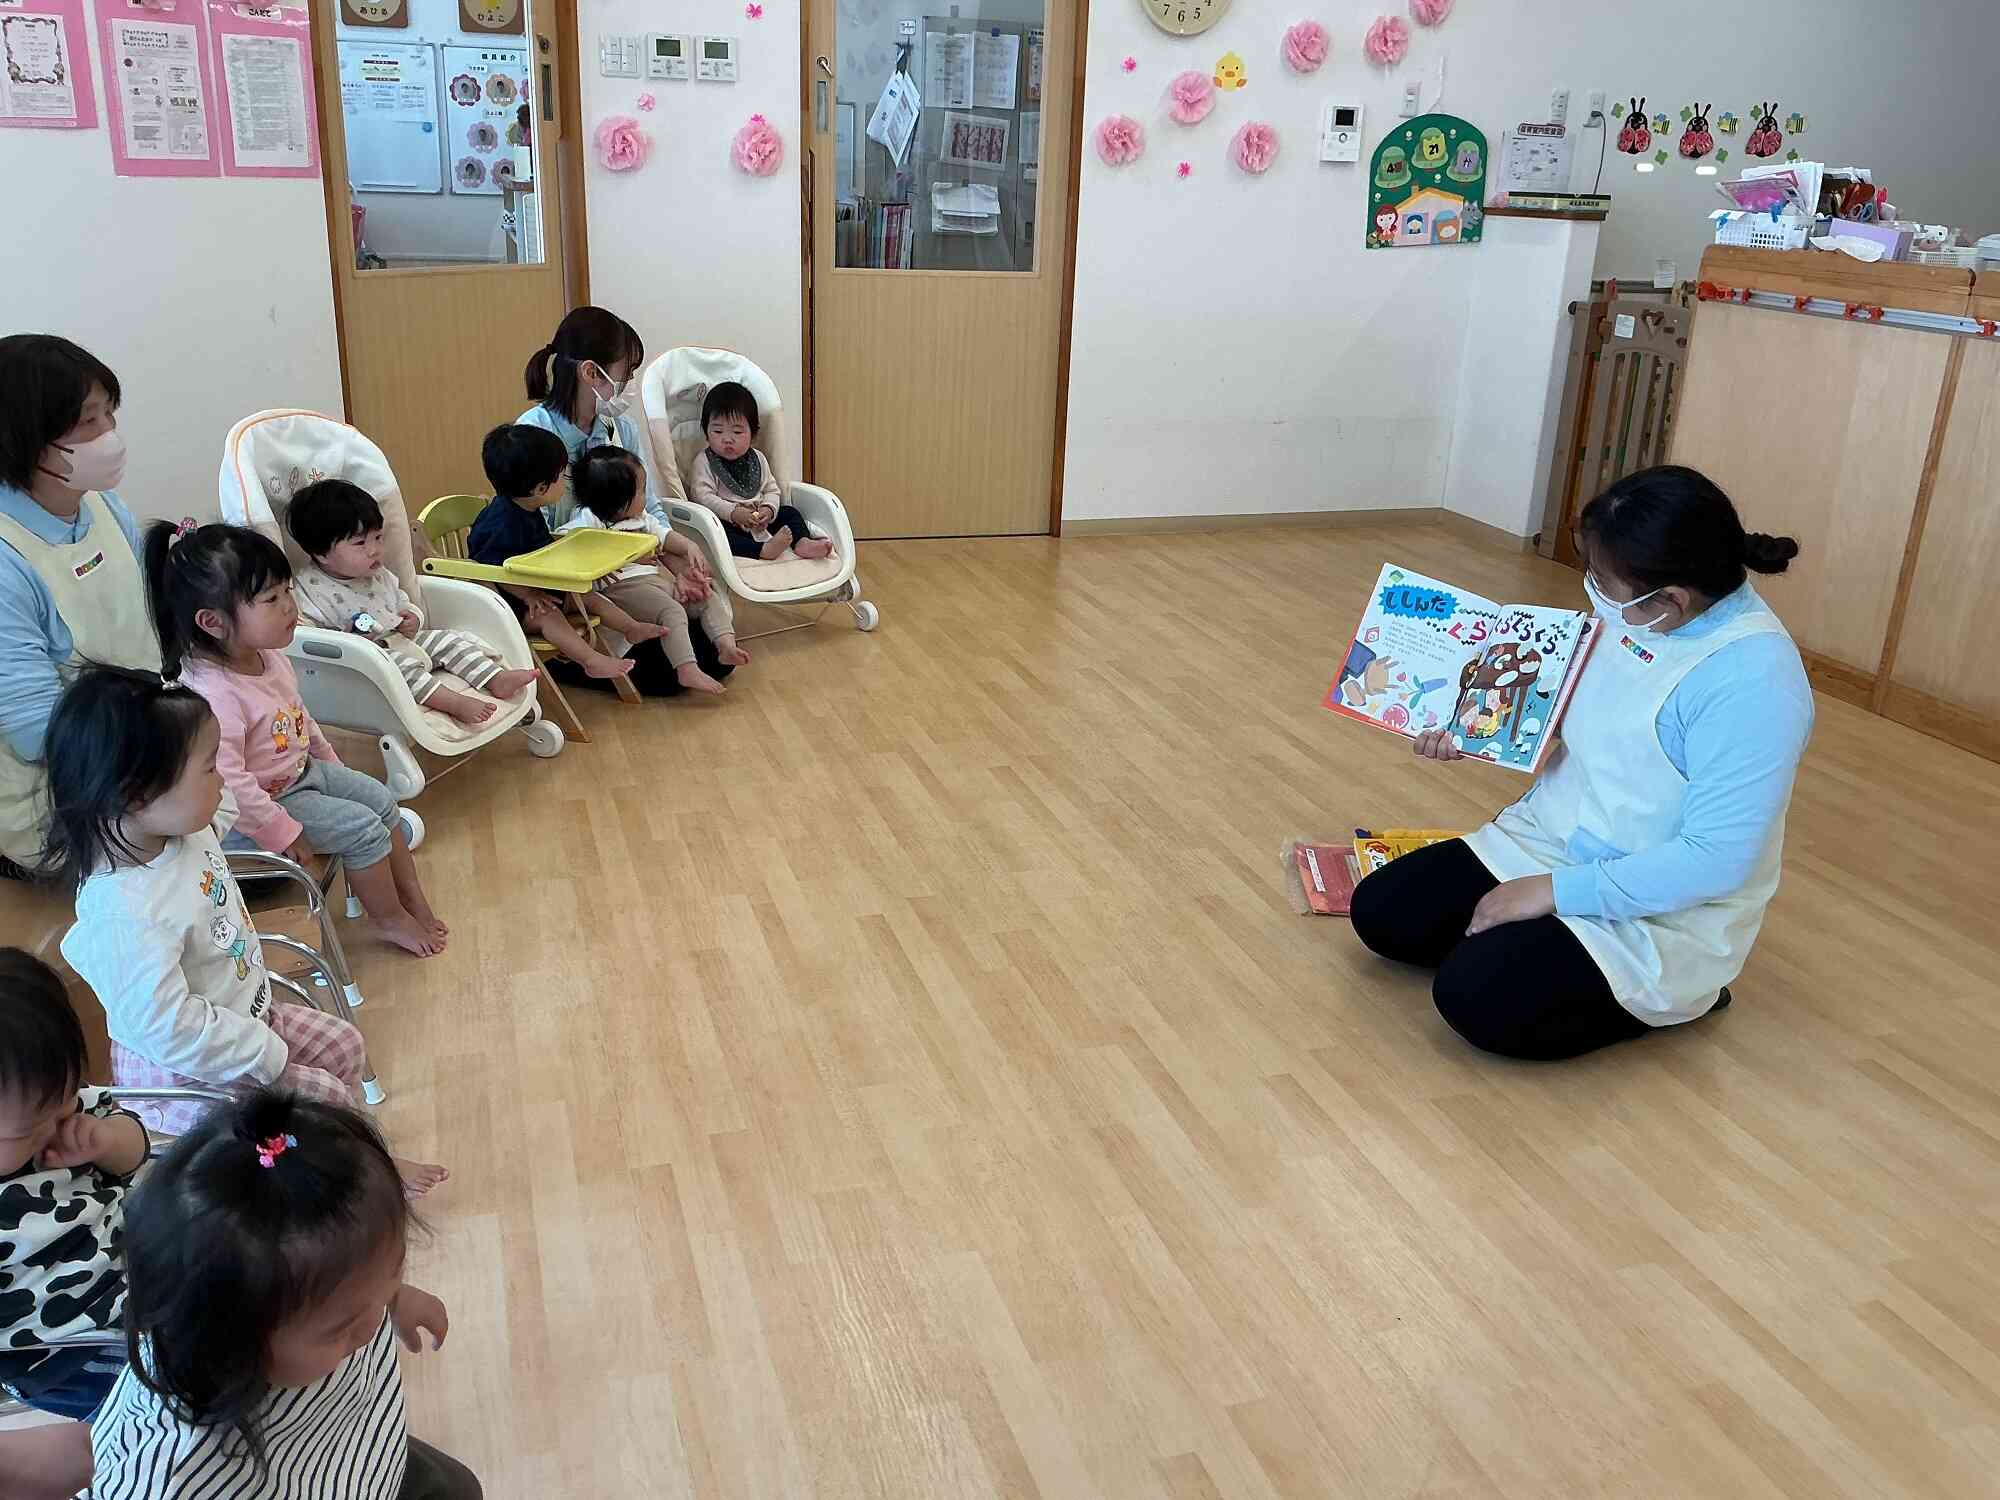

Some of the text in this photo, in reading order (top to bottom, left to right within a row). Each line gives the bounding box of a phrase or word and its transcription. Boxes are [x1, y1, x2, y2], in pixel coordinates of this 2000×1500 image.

[1163, 4, 1170, 16] 7
[1178, 10, 1185, 22] 6
[1193, 8, 1200, 19] 5
[1428, 143, 1439, 155] 21
